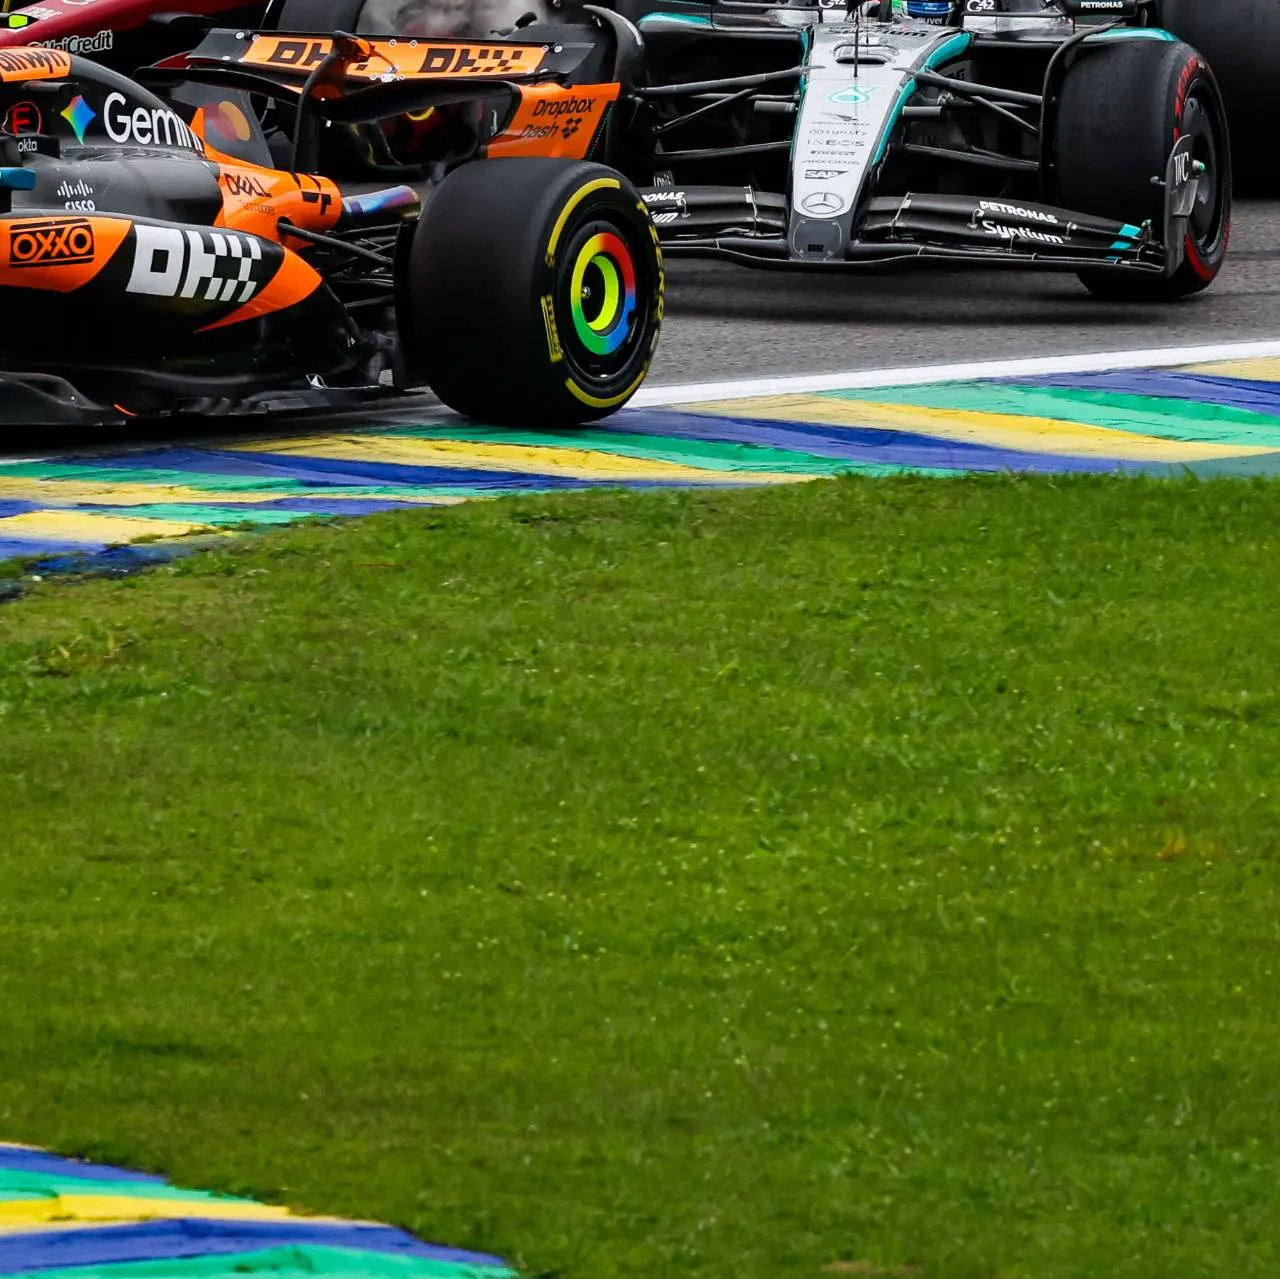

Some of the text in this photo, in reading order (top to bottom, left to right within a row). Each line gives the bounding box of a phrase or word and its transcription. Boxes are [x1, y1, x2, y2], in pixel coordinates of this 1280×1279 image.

[1080, 1, 1124, 9] PETRONAS
[531, 96, 596, 118] Dropbox
[520, 122, 559, 139] Dash
[17, 138, 38, 152] okta
[979, 200, 1058, 225] PETRONAS
[13, 223, 93, 262] OXXO
[982, 220, 1064, 245] Syntium
